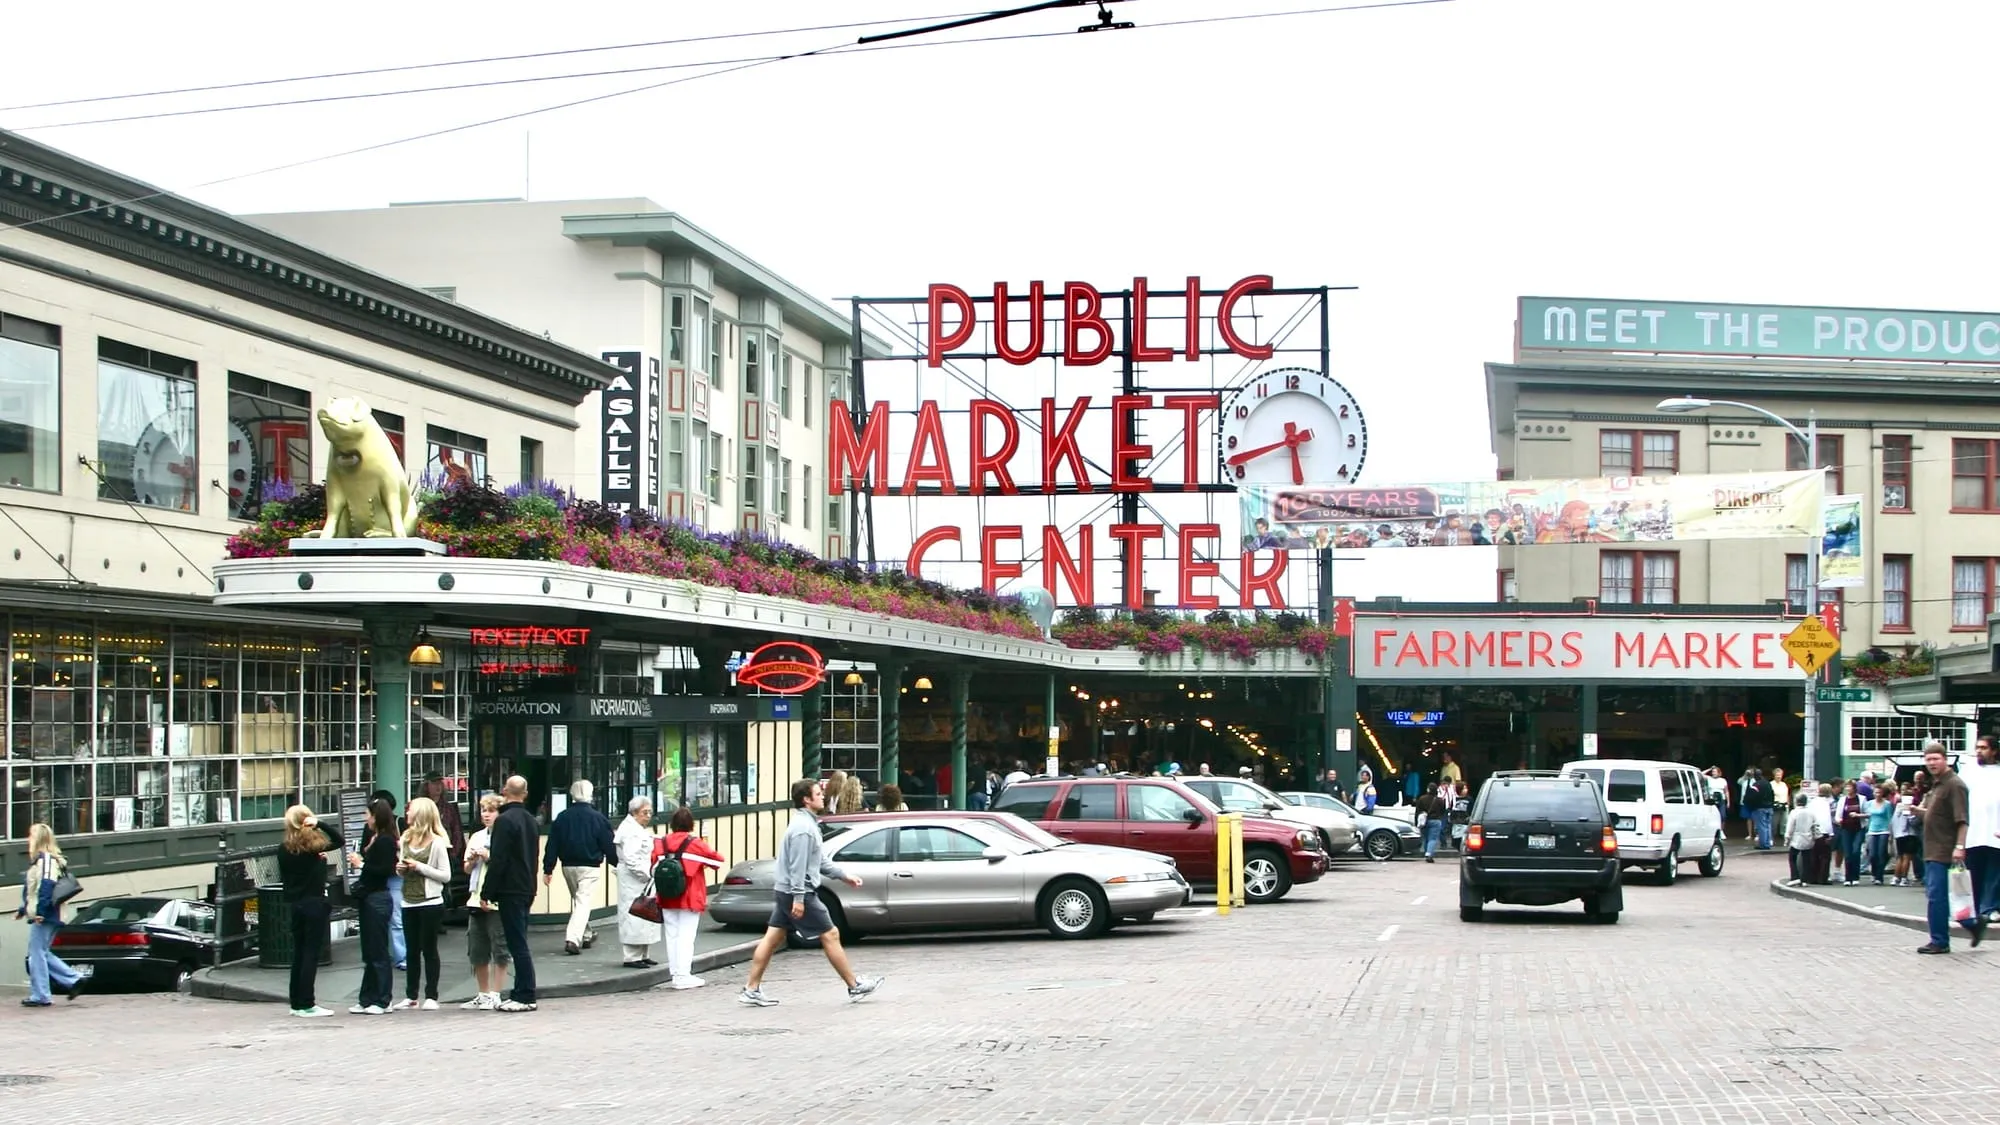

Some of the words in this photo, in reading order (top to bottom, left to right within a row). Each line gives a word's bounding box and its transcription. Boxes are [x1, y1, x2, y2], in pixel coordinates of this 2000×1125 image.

[928, 275, 1273, 367] PUBLIC
[1544, 306, 1666, 344] MEET
[1695, 311, 1778, 348] THE
[607, 357, 633, 391] LA
[650, 361, 658, 396] LA
[1286, 375, 1300, 390] 12
[1257, 383, 1268, 398] 11
[1235, 406, 1249, 420] 10
[1339, 405, 1349, 420] 2
[606, 399, 634, 489] SALLE
[828, 394, 1221, 495] MARKET
[1228, 436, 1238, 449] 9
[1347, 434, 1356, 448] 3
[650, 406, 658, 494] SALLE
[1235, 465, 1246, 479] 8
[1336, 463, 1348, 478] 4
[1330, 491, 1418, 507] YEARS
[1714, 488, 1750, 507] PIKE
[1354, 507, 1418, 519] SEATTLE
[907, 524, 1290, 610] CENTER
[1802, 624, 1823, 632] YIELD
[1373, 630, 1584, 668] FARMERS
[1788, 641, 1834, 649] PEDESTRIANS
[1820, 689, 1842, 700] Pike
[473, 702, 561, 715] NFORMATION
[590, 699, 642, 716] INFORMATION
[709, 704, 738, 714] INFORMATION
